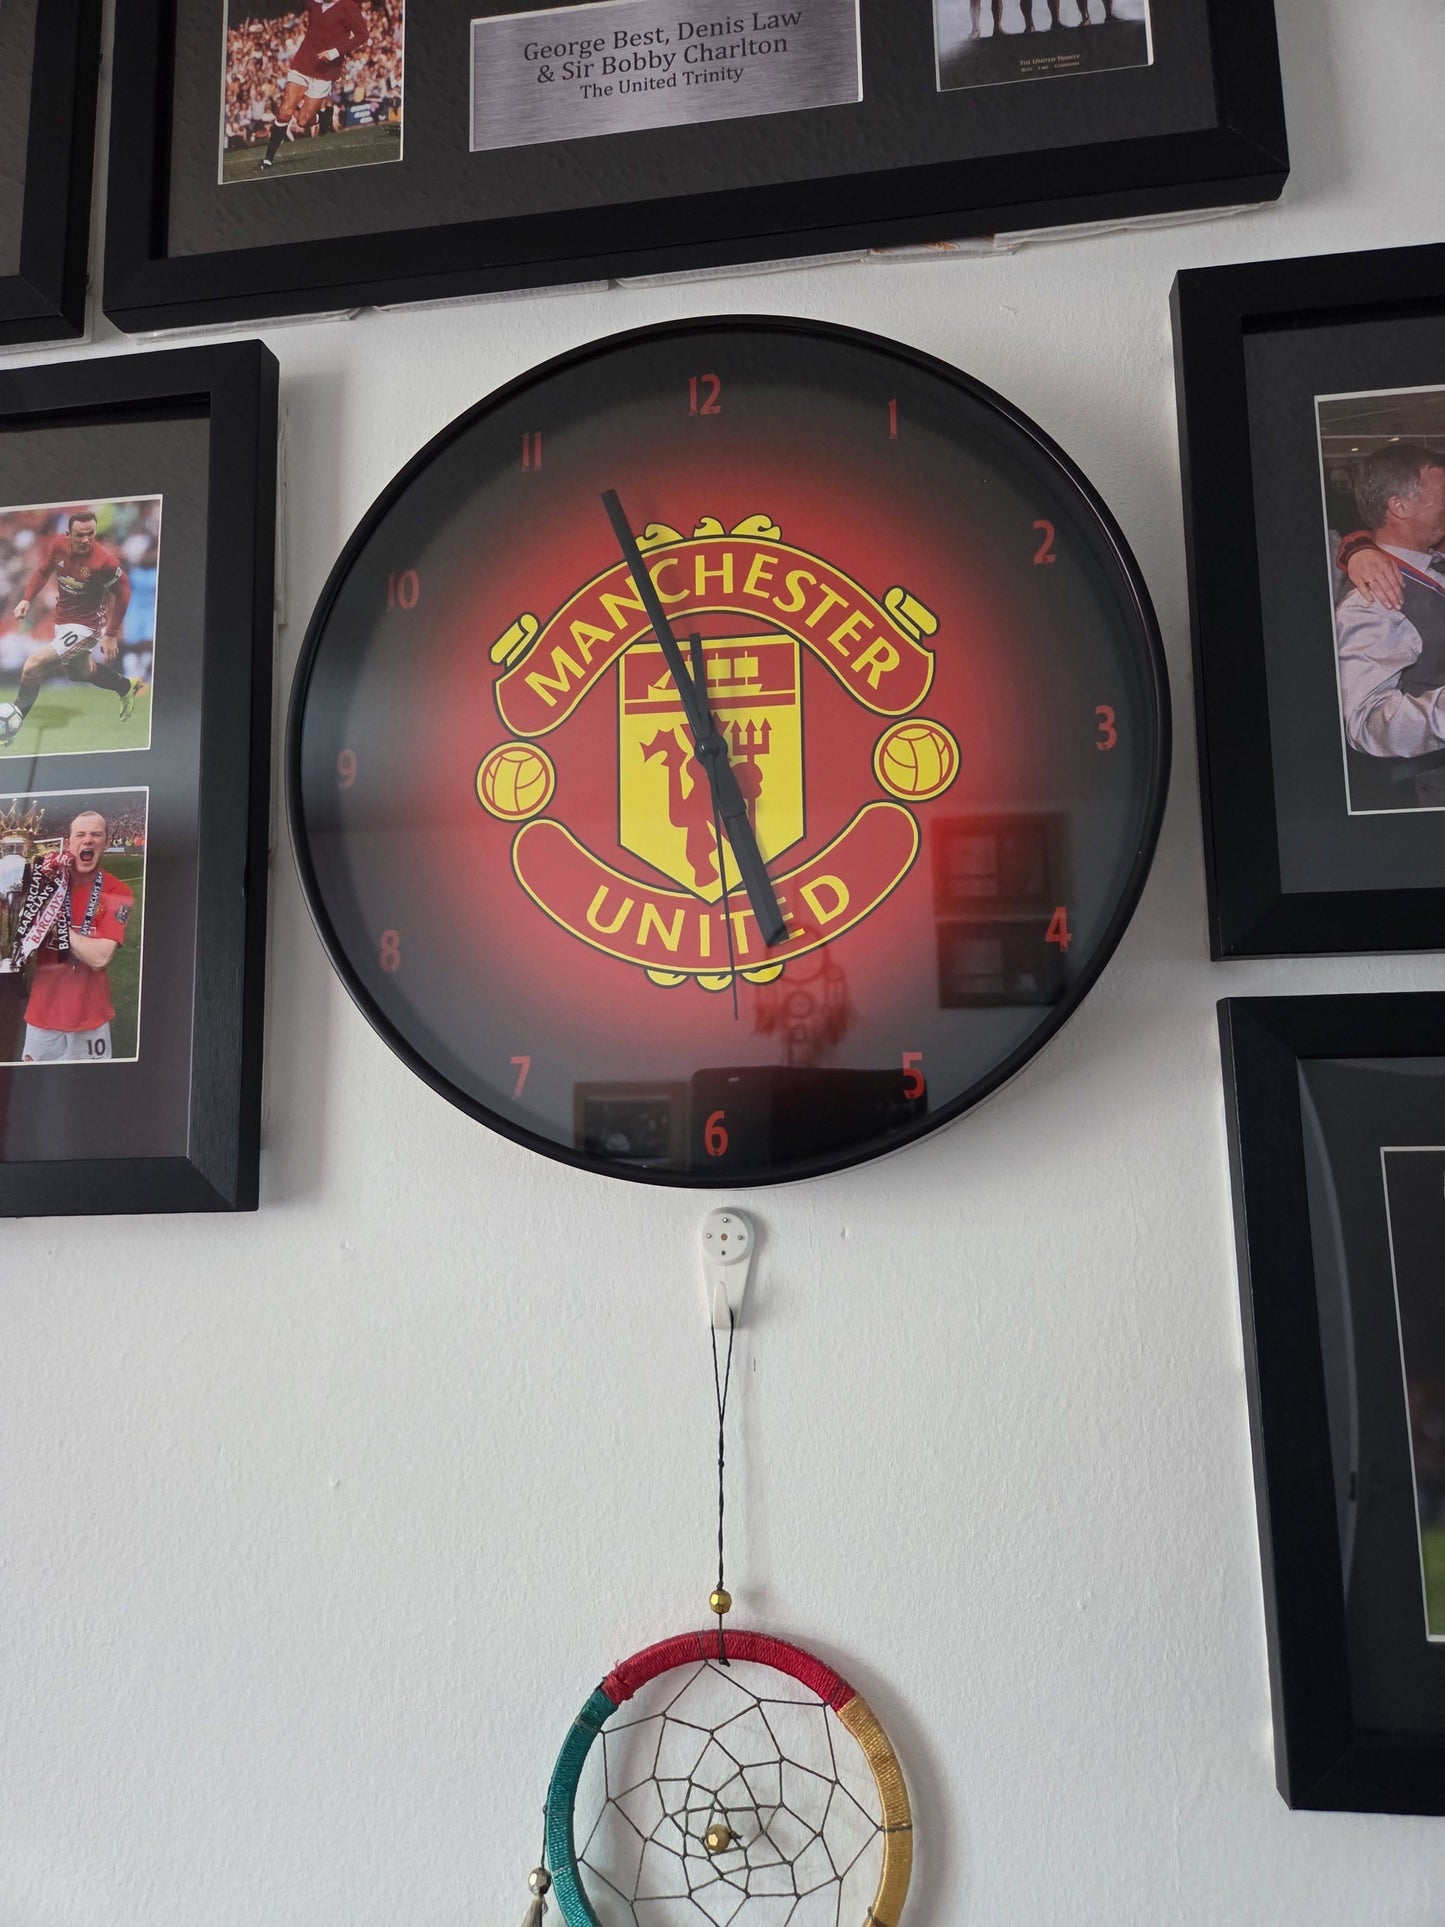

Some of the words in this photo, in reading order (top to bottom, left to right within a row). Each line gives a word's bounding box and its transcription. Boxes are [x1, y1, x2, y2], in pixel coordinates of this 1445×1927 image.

[523, 36, 605, 62] George
[613, 26, 670, 48] Best,
[677, 16, 744, 41] Denis
[751, 11, 802, 31] Law
[537, 64, 556, 84] &
[562, 60, 595, 82] Sir
[602, 49, 676, 76] Bobby
[683, 36, 789, 65] Charlton
[580, 82, 613, 100] The
[619, 73, 677, 95] United
[682, 66, 744, 87] Trinity
[688, 373, 722, 416] 12
[888, 398, 898, 440] 1
[521, 432, 543, 472] 11
[1032, 519, 1057, 564] 2
[386, 569, 420, 611] 10
[60, 631, 78, 647] 10
[524, 552, 901, 708] MANCHESTER
[1094, 705, 1118, 750] 3
[336, 748, 358, 790] 9
[17, 884, 54, 935] BARCLAYS
[31, 892, 64, 944] BARCLAYS
[87, 885, 101, 917] BARCLAYS
[379, 928, 401, 974] 8
[1045, 906, 1072, 952] 4
[87, 1038, 106, 1056] 10
[510, 1055, 531, 1101] 7
[902, 1051, 926, 1100] 5
[704, 1110, 729, 1157] 6
